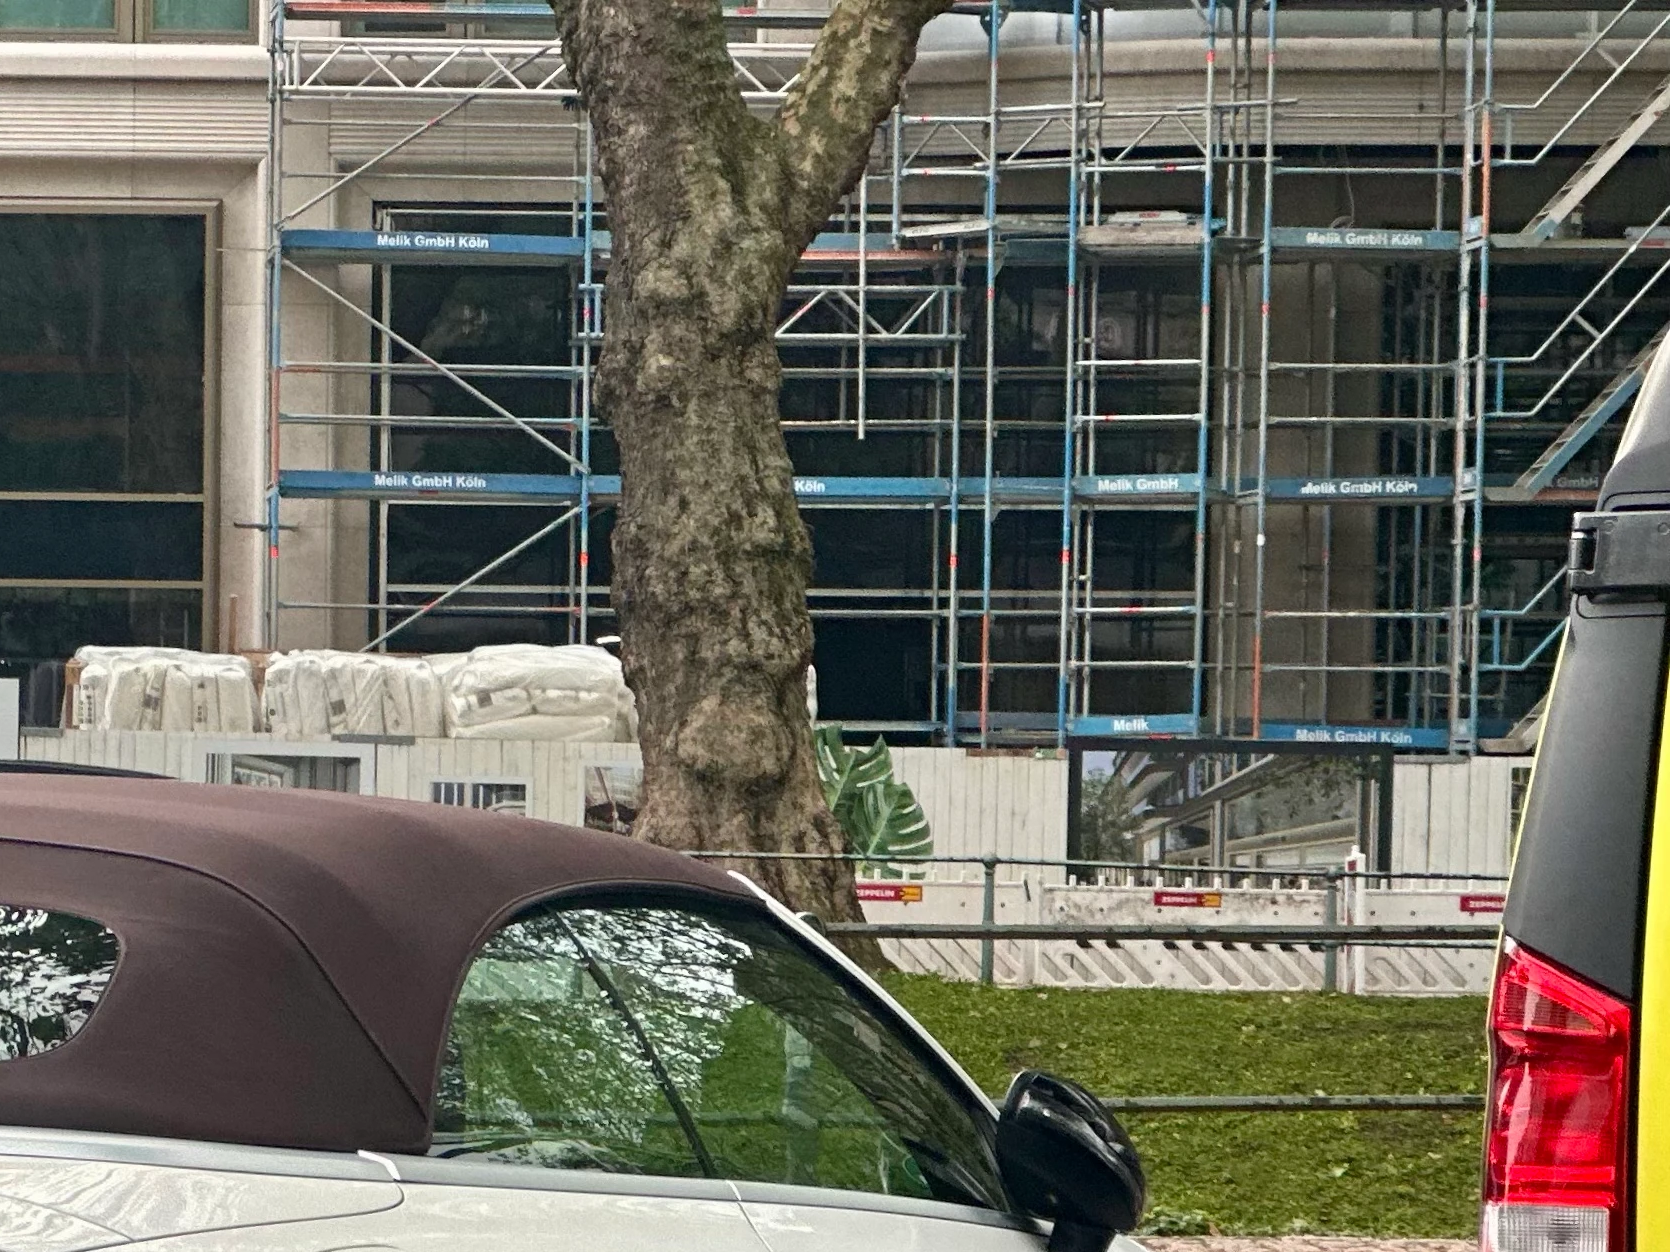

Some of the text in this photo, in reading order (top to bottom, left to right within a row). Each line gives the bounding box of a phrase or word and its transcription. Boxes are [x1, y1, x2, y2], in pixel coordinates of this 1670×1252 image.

[376, 234, 490, 249] Melik GmbH Köln
[1344, 232, 1388, 246] GmbH
[374, 473, 487, 488] Melik GmbH Köln
[793, 479, 827, 493] Köln
[1097, 477, 1180, 492] Melik GmbH
[1339, 481, 1383, 494] GmbH
[1385, 481, 1418, 493] Köln
[1113, 718, 1151, 731] Melik
[1295, 728, 1413, 744] Melik GmbH Köln
